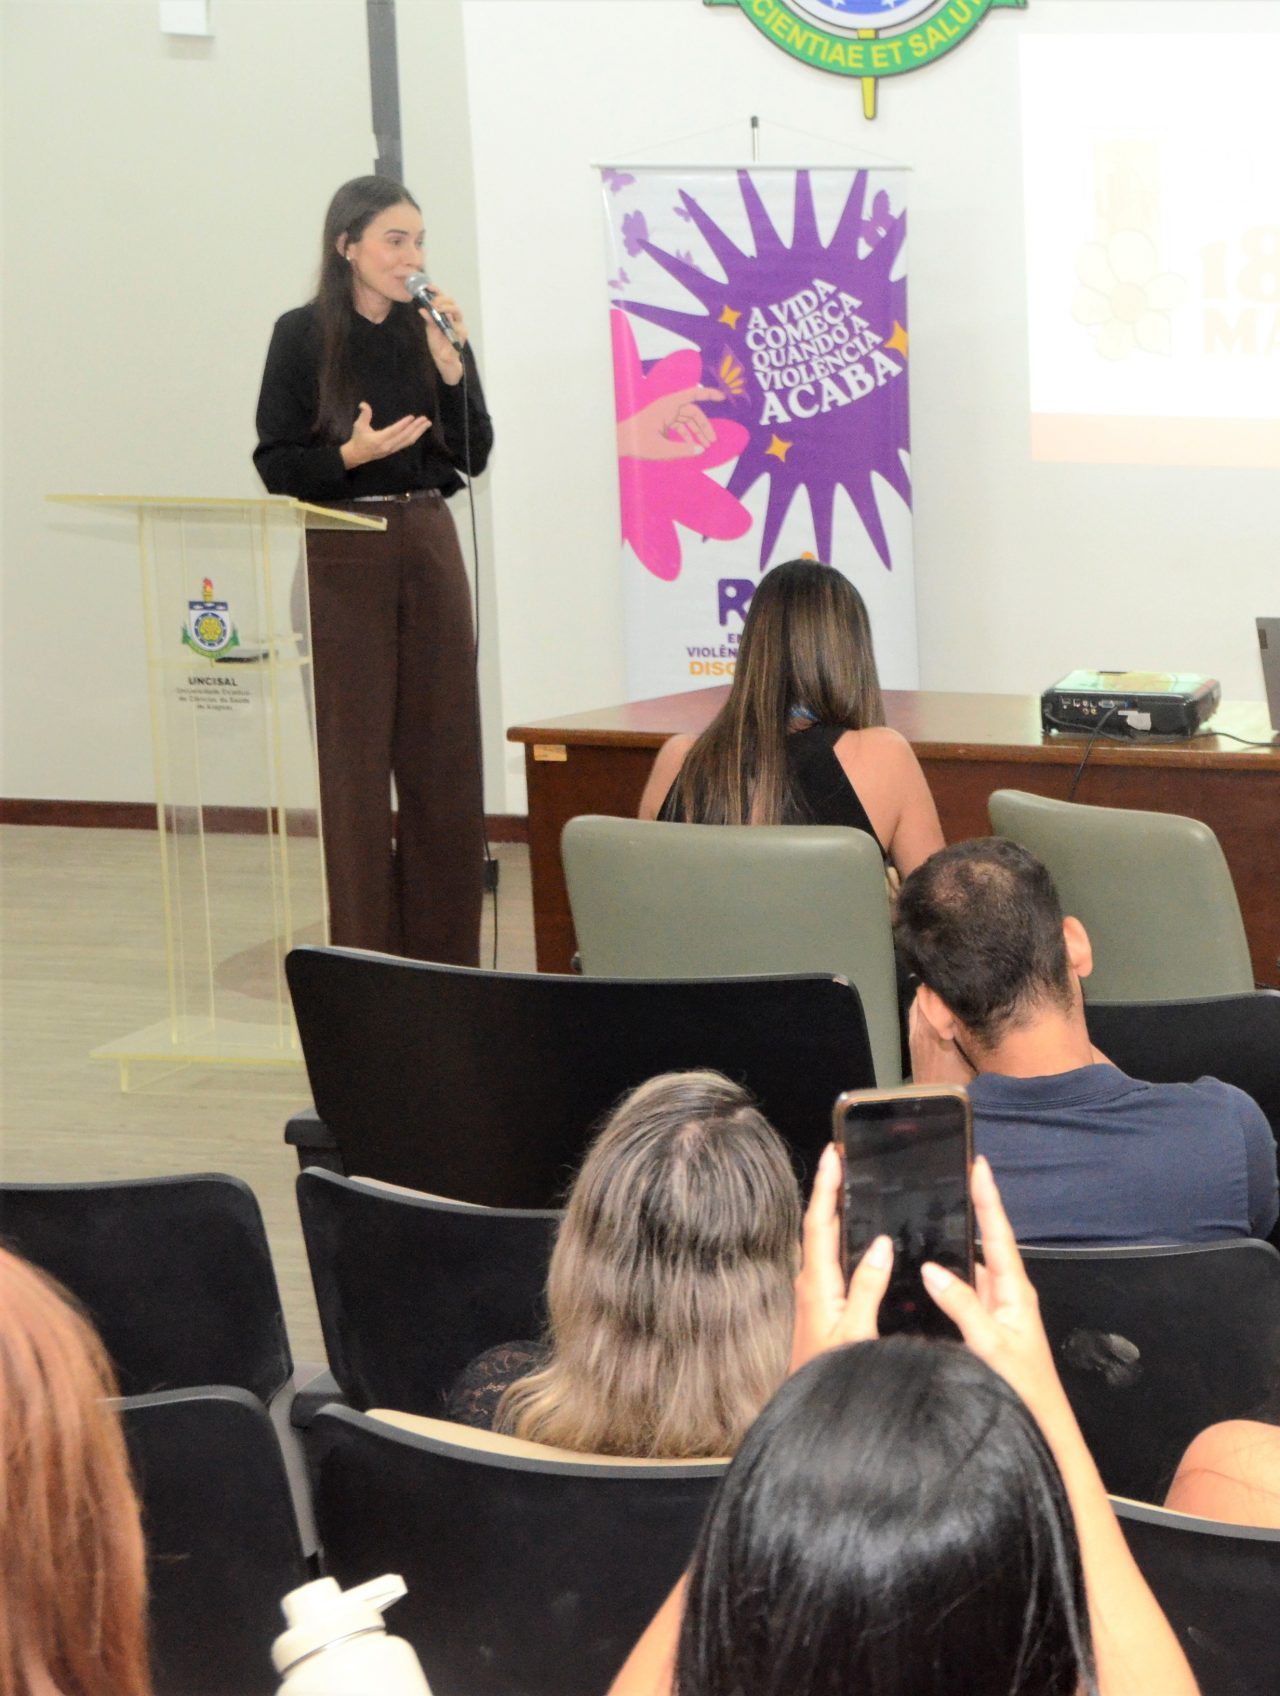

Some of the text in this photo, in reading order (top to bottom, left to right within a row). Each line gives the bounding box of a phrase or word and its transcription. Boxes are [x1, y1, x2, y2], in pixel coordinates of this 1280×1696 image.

[752, 0, 981, 69] CIENTIAE ET SALU
[748, 278, 837, 330] A VIDA
[752, 314, 870, 372] QUANDO A
[754, 330, 884, 391] VIOLÊNCIA
[759, 350, 904, 426] ACABA
[687, 645, 738, 658] VIOLÊN
[188, 676, 238, 687] UNCISAL
